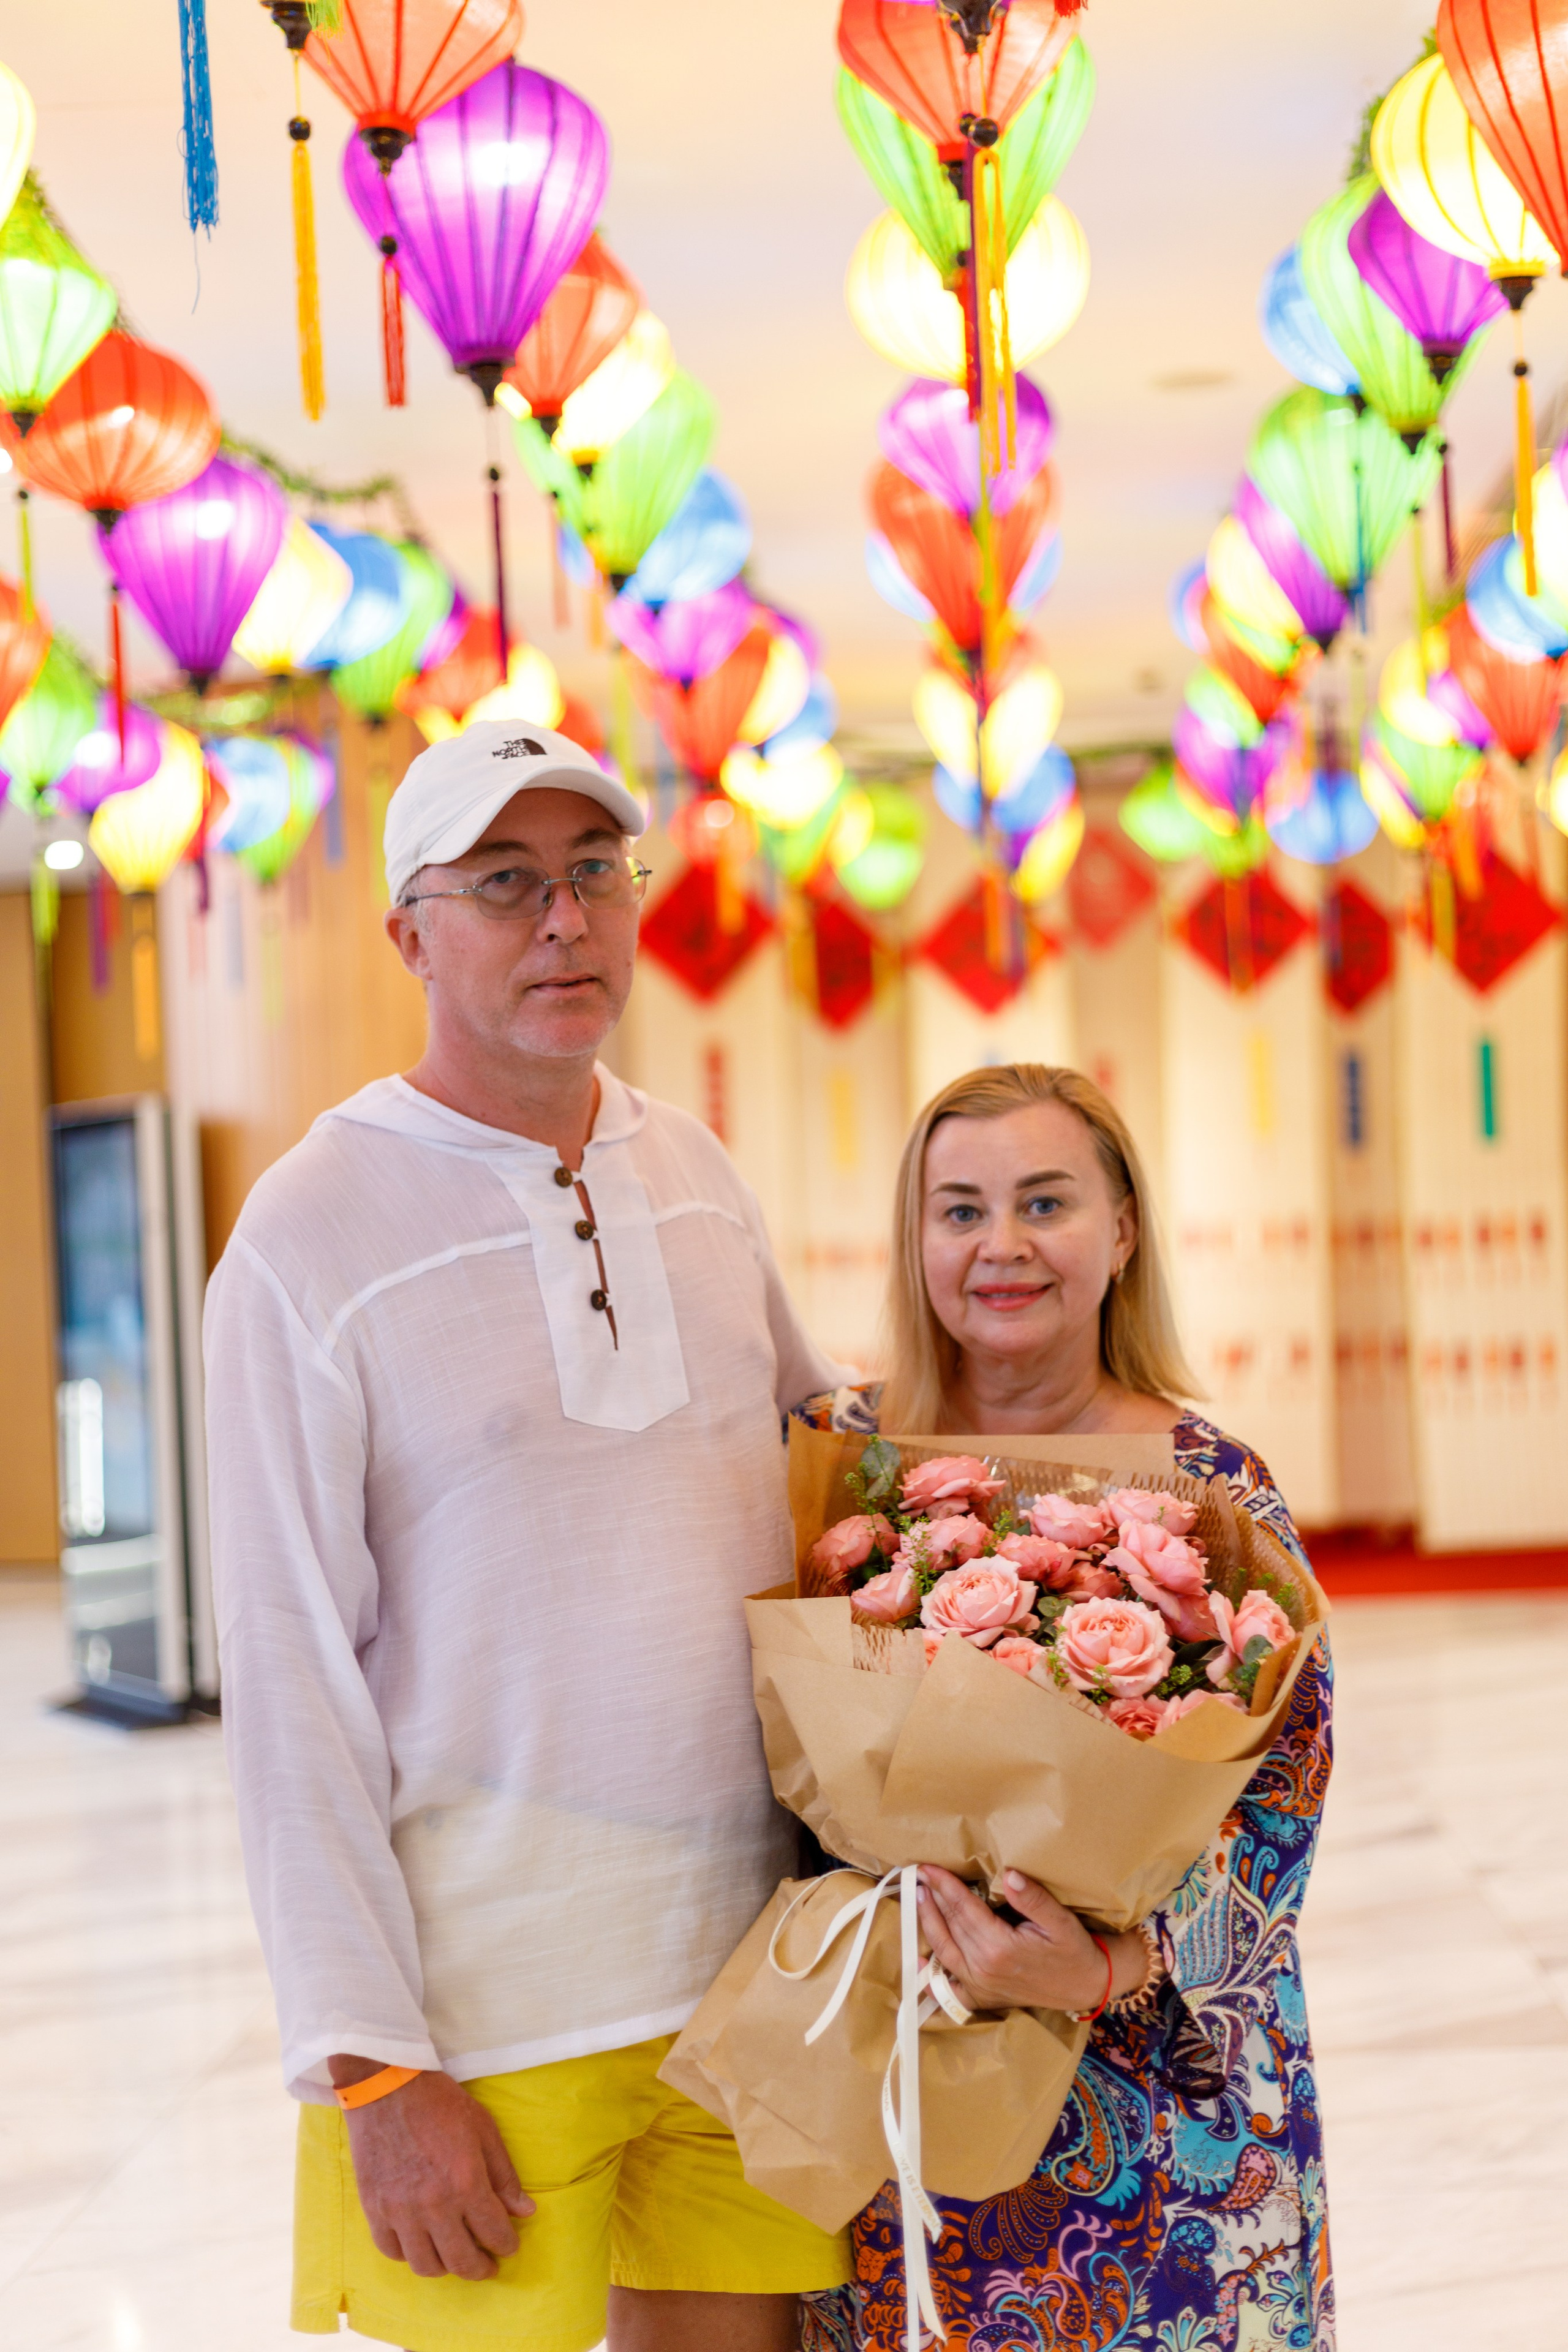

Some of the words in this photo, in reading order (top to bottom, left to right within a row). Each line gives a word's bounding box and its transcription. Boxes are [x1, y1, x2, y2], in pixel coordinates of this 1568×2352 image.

[503, 739, 526, 748] THE
[492, 744, 529, 757] NORTH
[502, 751, 531, 760] FACE
[892, 2140, 911, 2174] LOVE
[906, 2174, 917, 2186] IS
